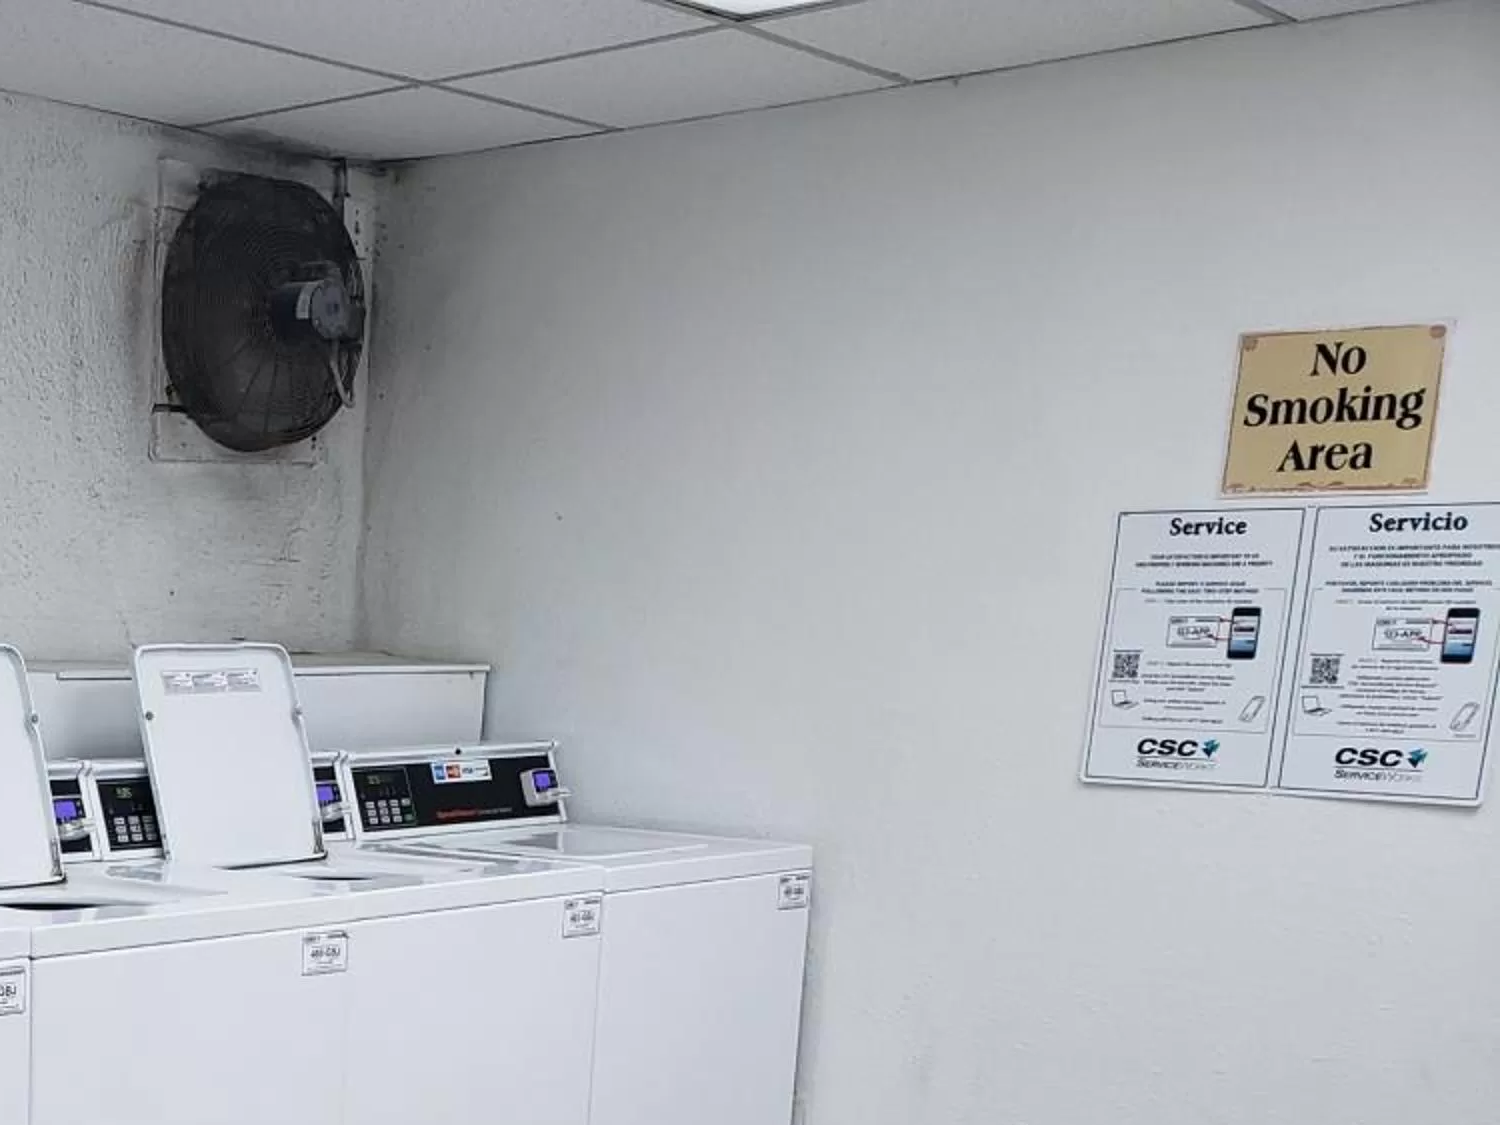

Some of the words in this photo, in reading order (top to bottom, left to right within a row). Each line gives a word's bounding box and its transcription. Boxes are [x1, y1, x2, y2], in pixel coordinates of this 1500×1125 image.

[1310, 342, 1366, 376] No
[1243, 385, 1426, 430] Smoking
[1276, 440, 1373, 472] Area
[1169, 517, 1248, 536] Service
[1369, 512, 1468, 532] Servicio
[1137, 738, 1199, 757] CSC
[1335, 747, 1403, 768] CSC
